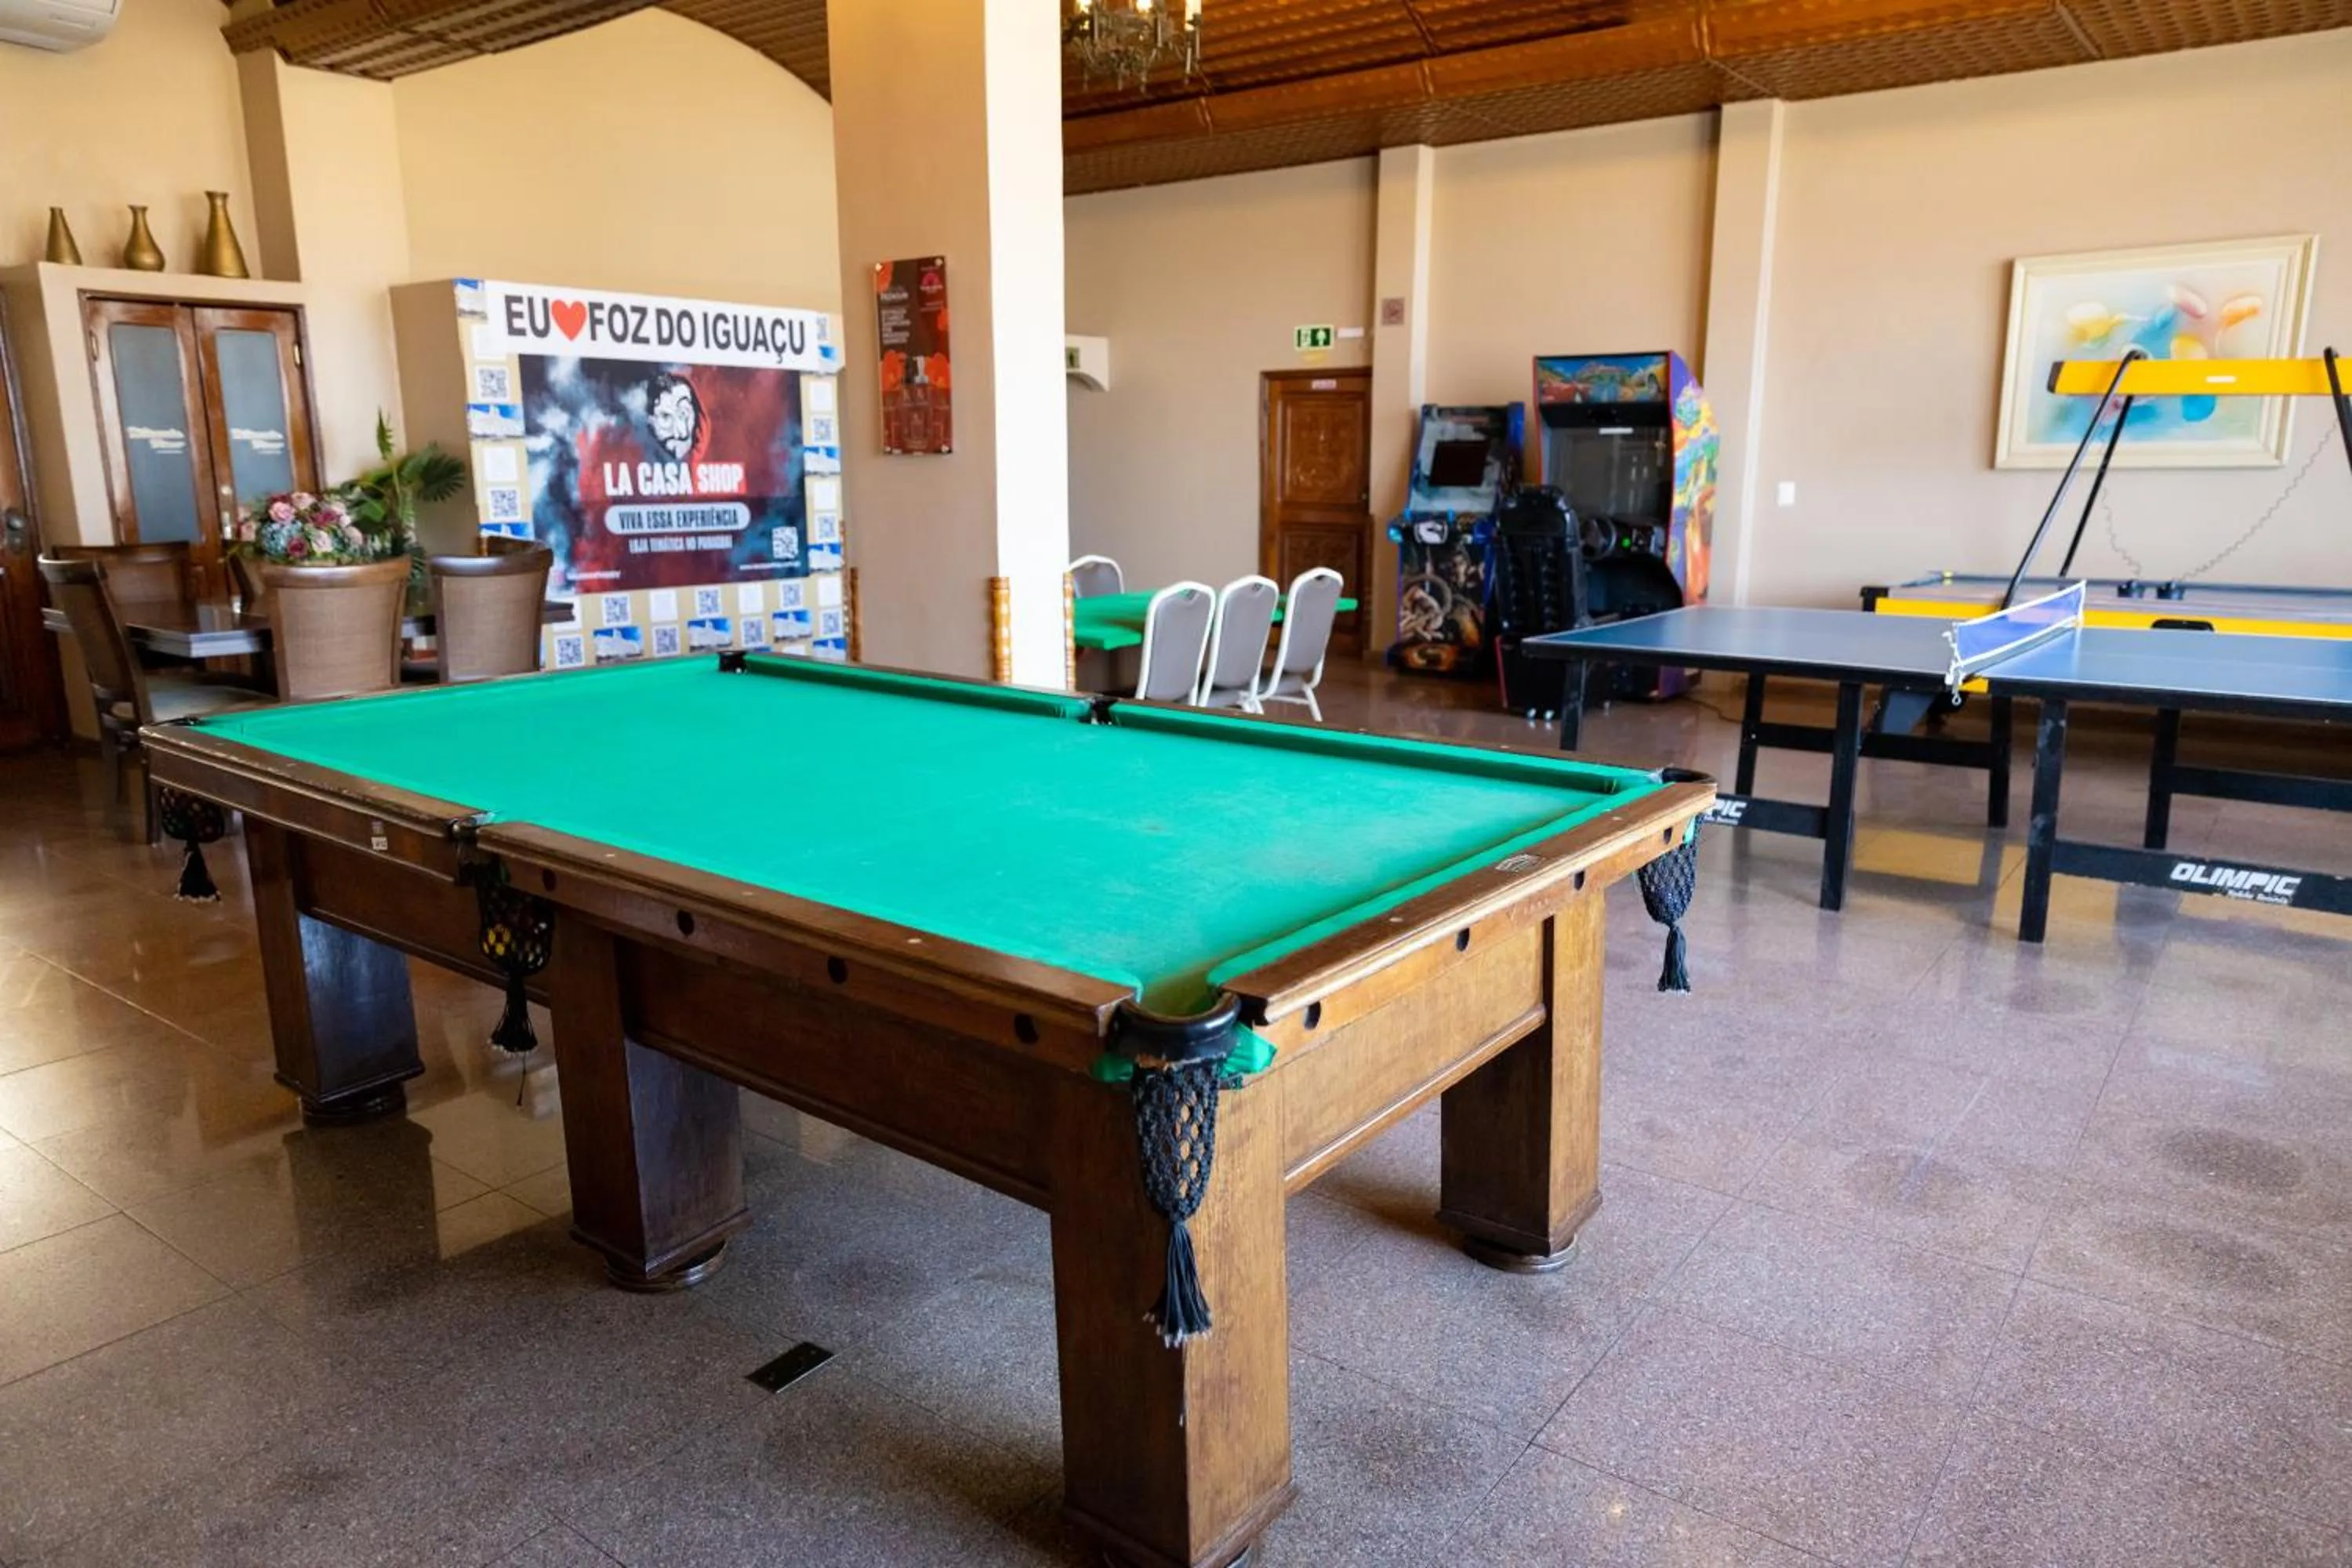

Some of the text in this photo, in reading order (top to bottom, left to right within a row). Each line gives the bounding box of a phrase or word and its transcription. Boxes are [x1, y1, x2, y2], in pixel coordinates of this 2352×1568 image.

[505, 295, 804, 364] EU FOZ DO IGUAÇU
[604, 461, 744, 496] LA CASA SHOP
[619, 511, 643, 529] VIVA
[647, 510, 673, 529] ESSA
[2170, 862, 2302, 895] OLIMPIC
